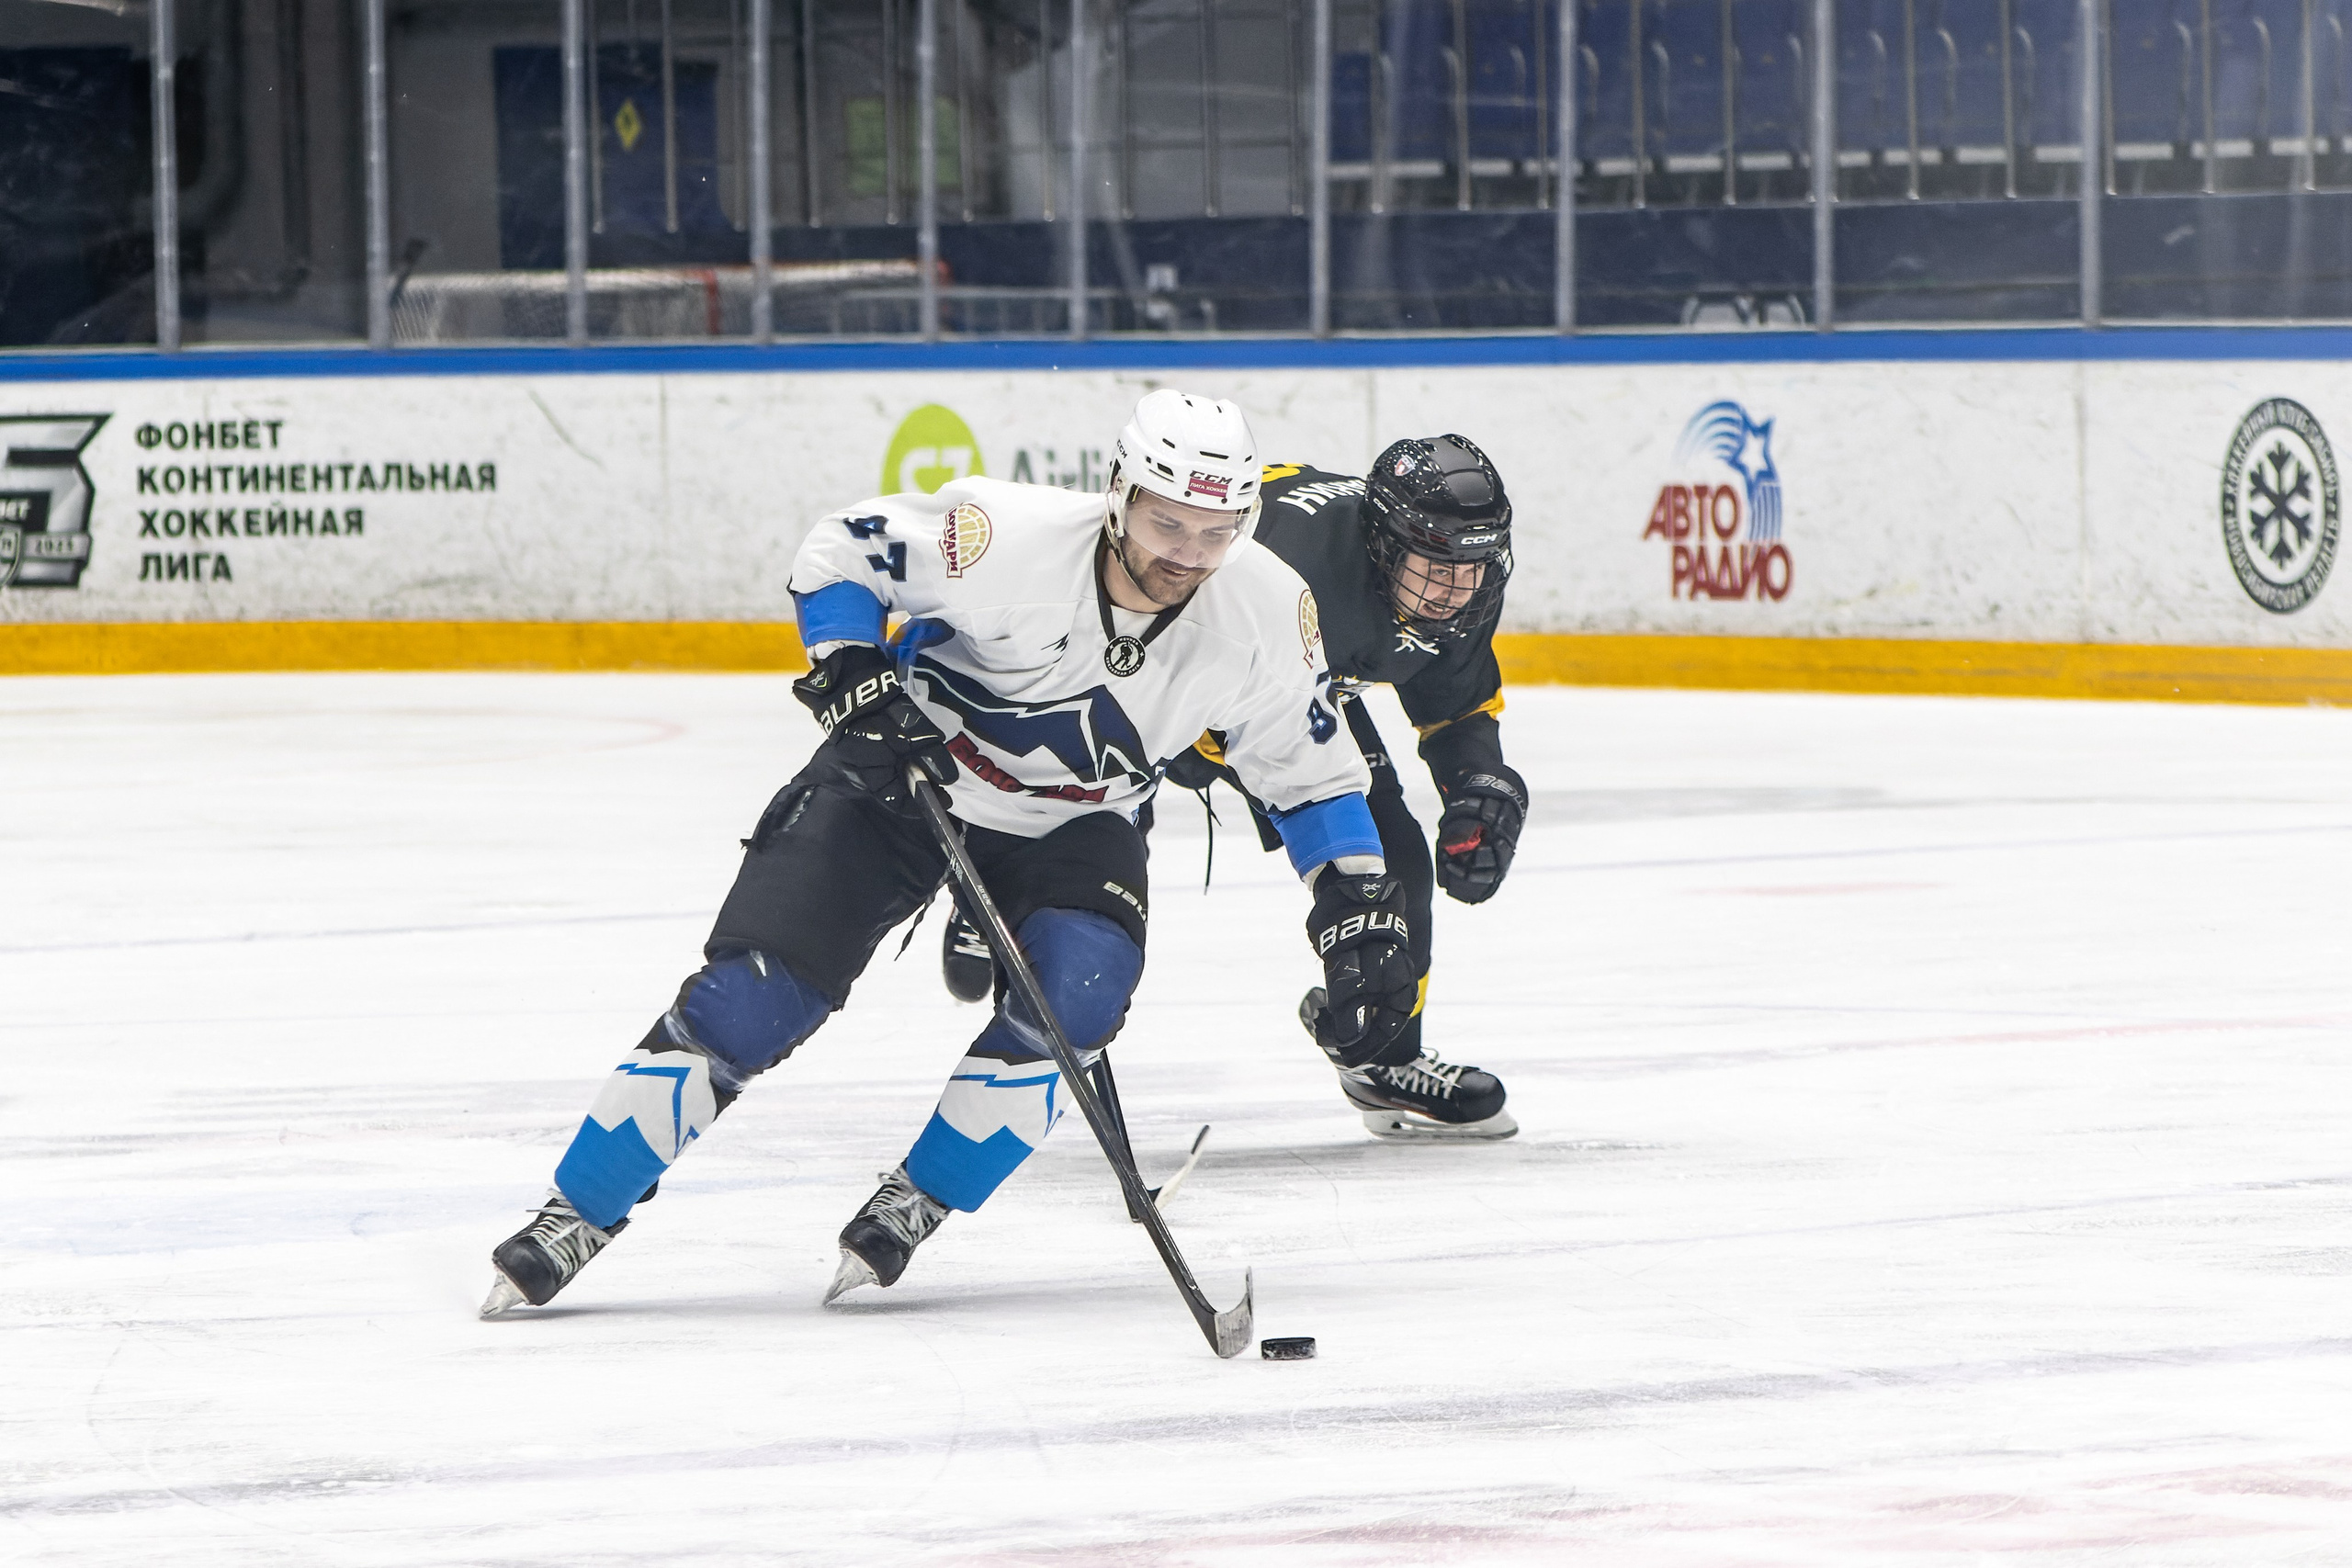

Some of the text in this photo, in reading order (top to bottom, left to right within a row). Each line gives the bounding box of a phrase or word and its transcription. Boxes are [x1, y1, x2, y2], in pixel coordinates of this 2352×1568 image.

[135, 419, 285, 450] ФОНБЕТ
[1116, 439, 1128, 459] CCM
[137, 462, 498, 496] КОНТИНЕНТАЛЬНАЯ
[1189, 469, 1233, 485] CCM
[139, 500, 365, 538] ХОККЕЙНАЯ
[1640, 484, 1739, 541] АВТО
[1461, 533, 1498, 546] CCM
[139, 552, 233, 582] ЛИГА
[1671, 544, 1792, 602] РАДИО
